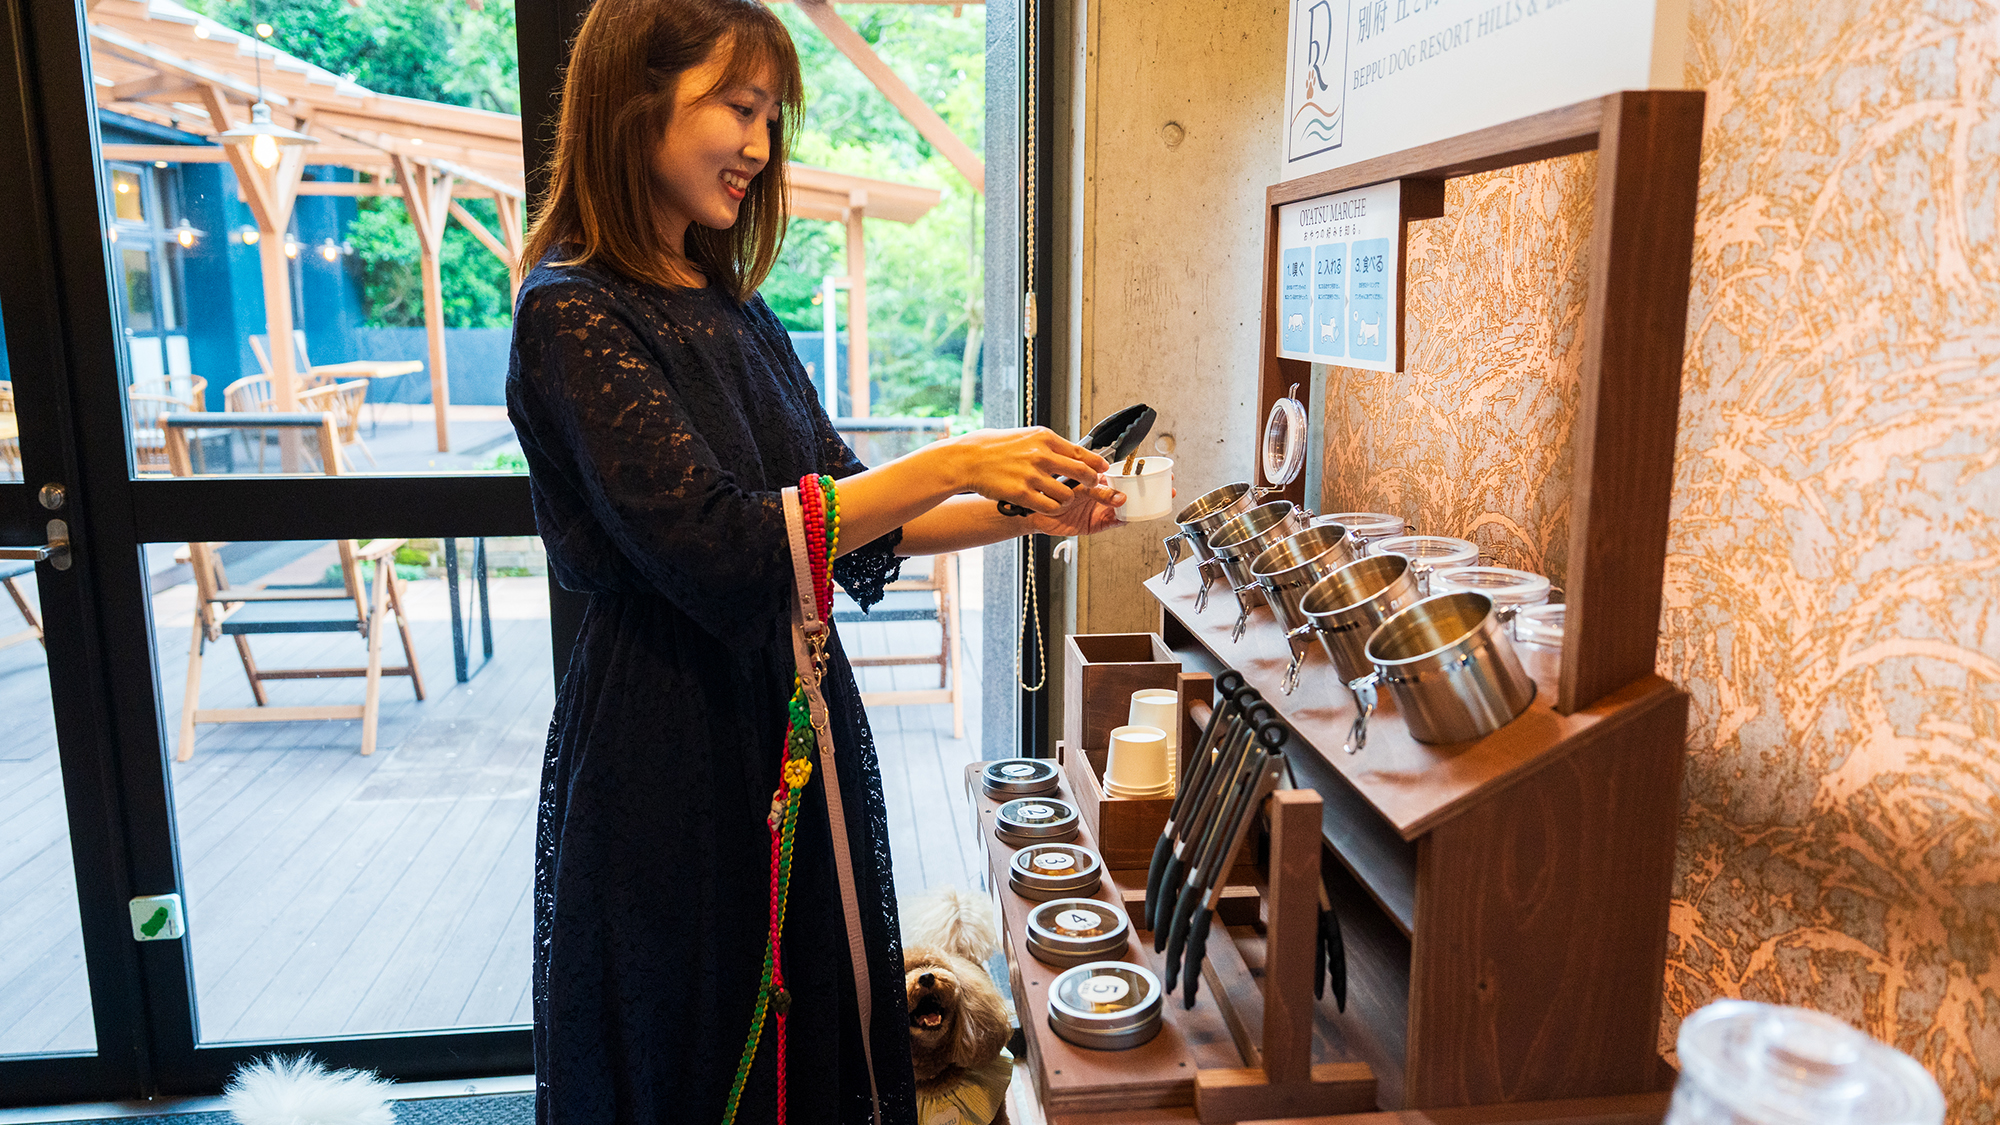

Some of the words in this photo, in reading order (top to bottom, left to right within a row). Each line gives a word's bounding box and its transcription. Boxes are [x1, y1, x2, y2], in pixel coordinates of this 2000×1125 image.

[1353, 57, 1386, 90] BEPPU
[1388, 44, 1416, 75] DOG
[1420, 18, 1473, 62] RESORT
[1477, 0, 1522, 38] HILLS
[1299, 205, 1329, 227] OYATSU
[1329, 198, 1367, 222] MARCHE
[1045, 857, 1067, 865] 3
[1071, 913, 1087, 923] 4
[1093, 984, 1118, 993] 5
